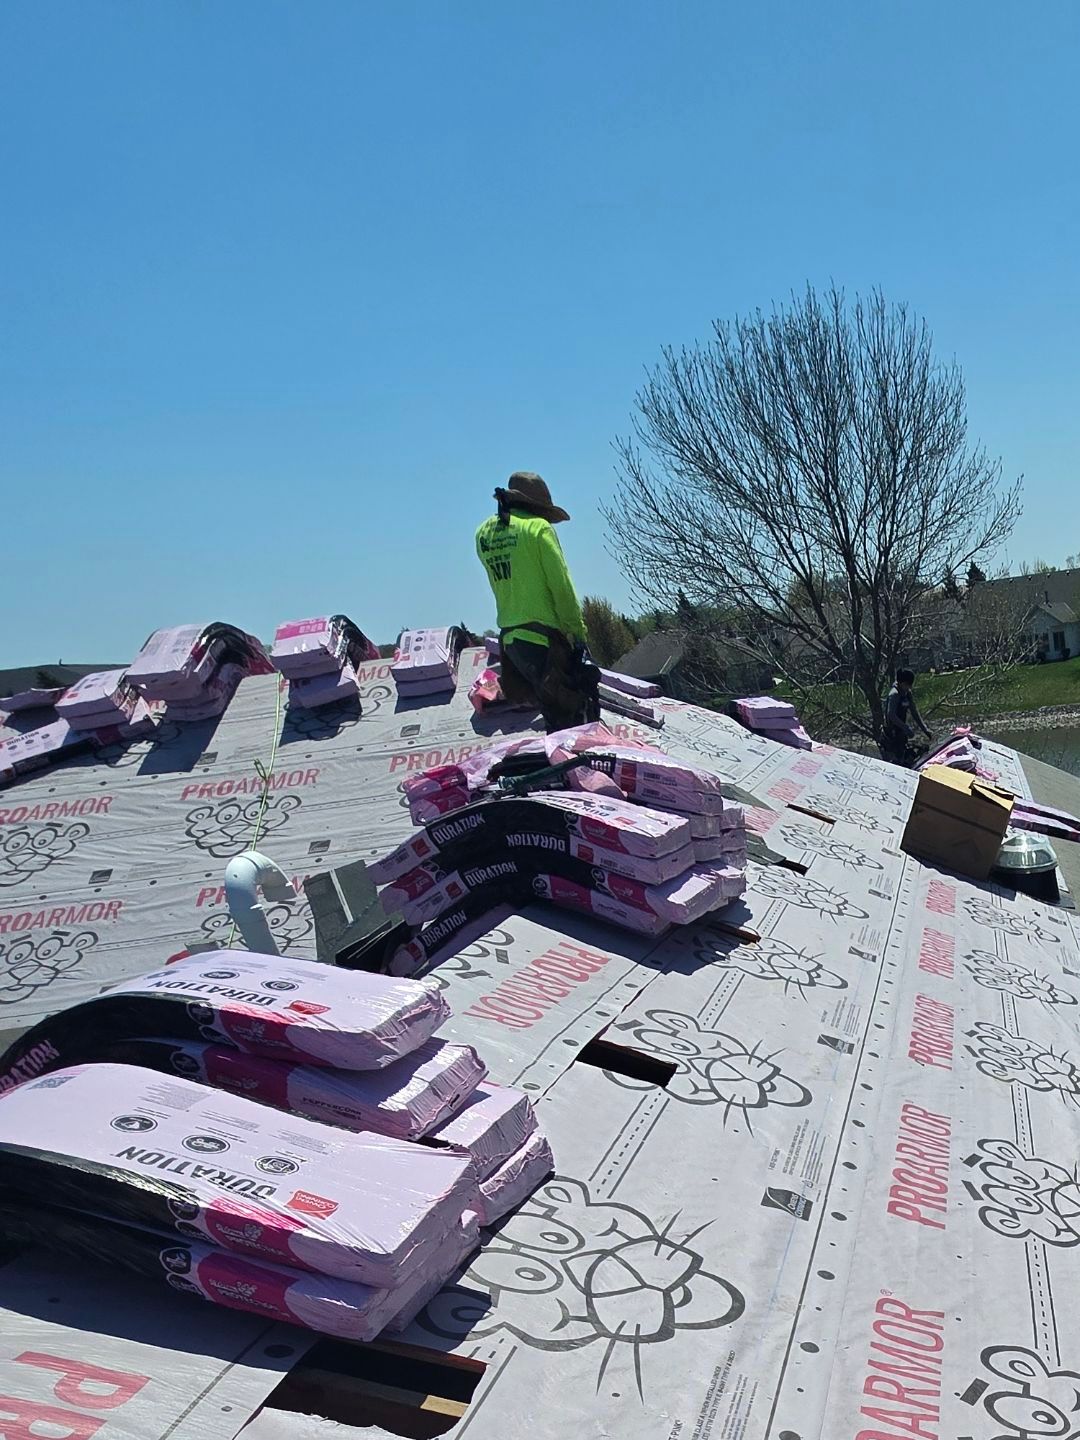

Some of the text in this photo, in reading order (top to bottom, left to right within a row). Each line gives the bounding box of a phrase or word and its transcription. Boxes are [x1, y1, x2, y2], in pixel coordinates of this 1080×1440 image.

[0, 796, 113, 826] ROARMOR
[0, 900, 123, 934] ROARMOR
[462, 941, 612, 1029] PROARMOR
[887, 1102, 952, 1231] PROARMOR
